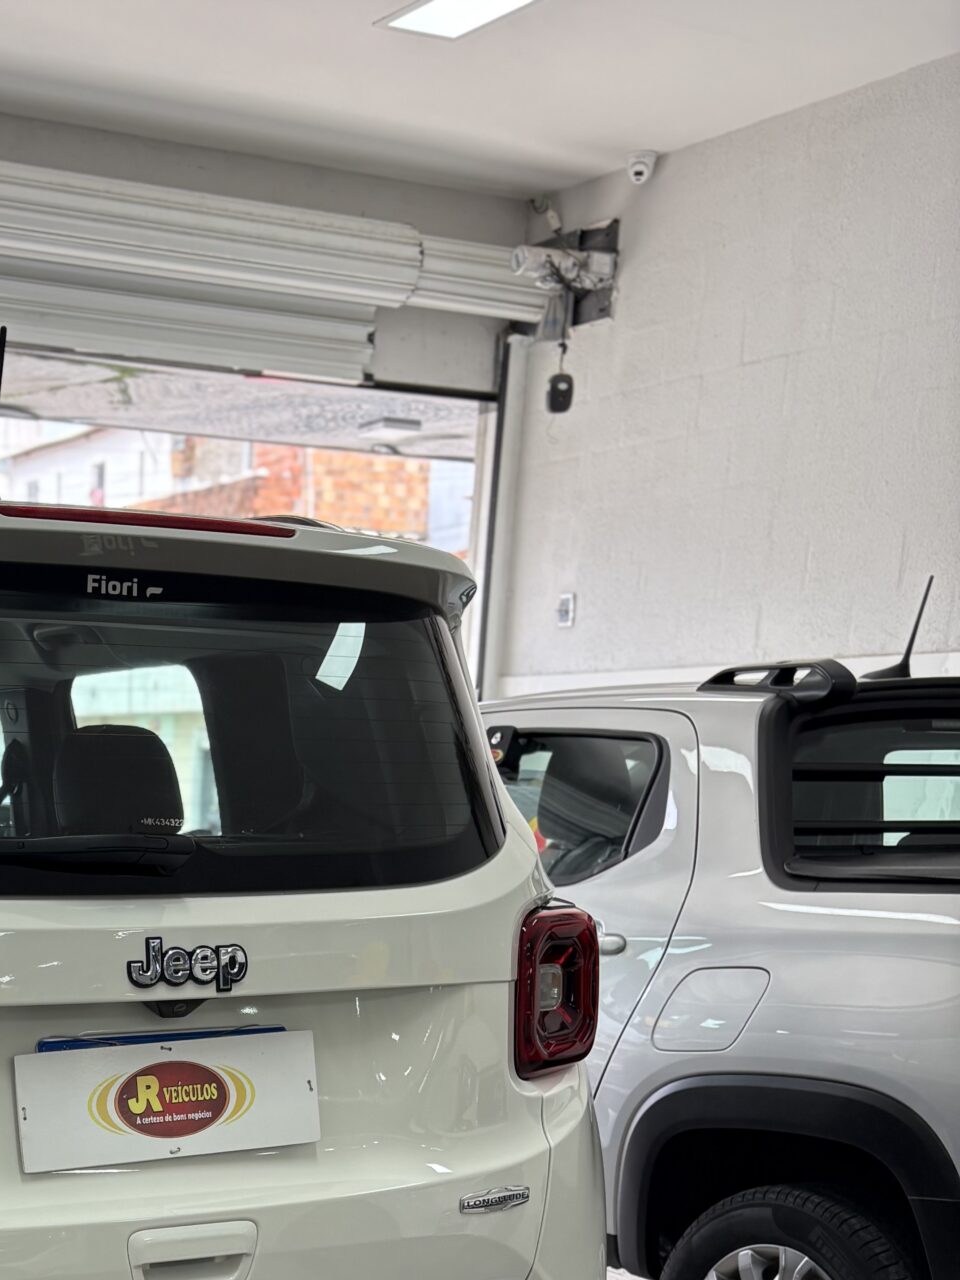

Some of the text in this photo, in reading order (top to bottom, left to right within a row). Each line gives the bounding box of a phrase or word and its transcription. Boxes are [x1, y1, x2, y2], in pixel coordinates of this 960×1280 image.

[86, 574, 138, 597] Fiori
[127, 936, 248, 993] Jeep
[127, 1074, 218, 1115] JR VEÍCULOS
[136, 1110, 212, 1125] A certeza de bons negócios
[465, 1191, 527, 1208] LONGITUDE
